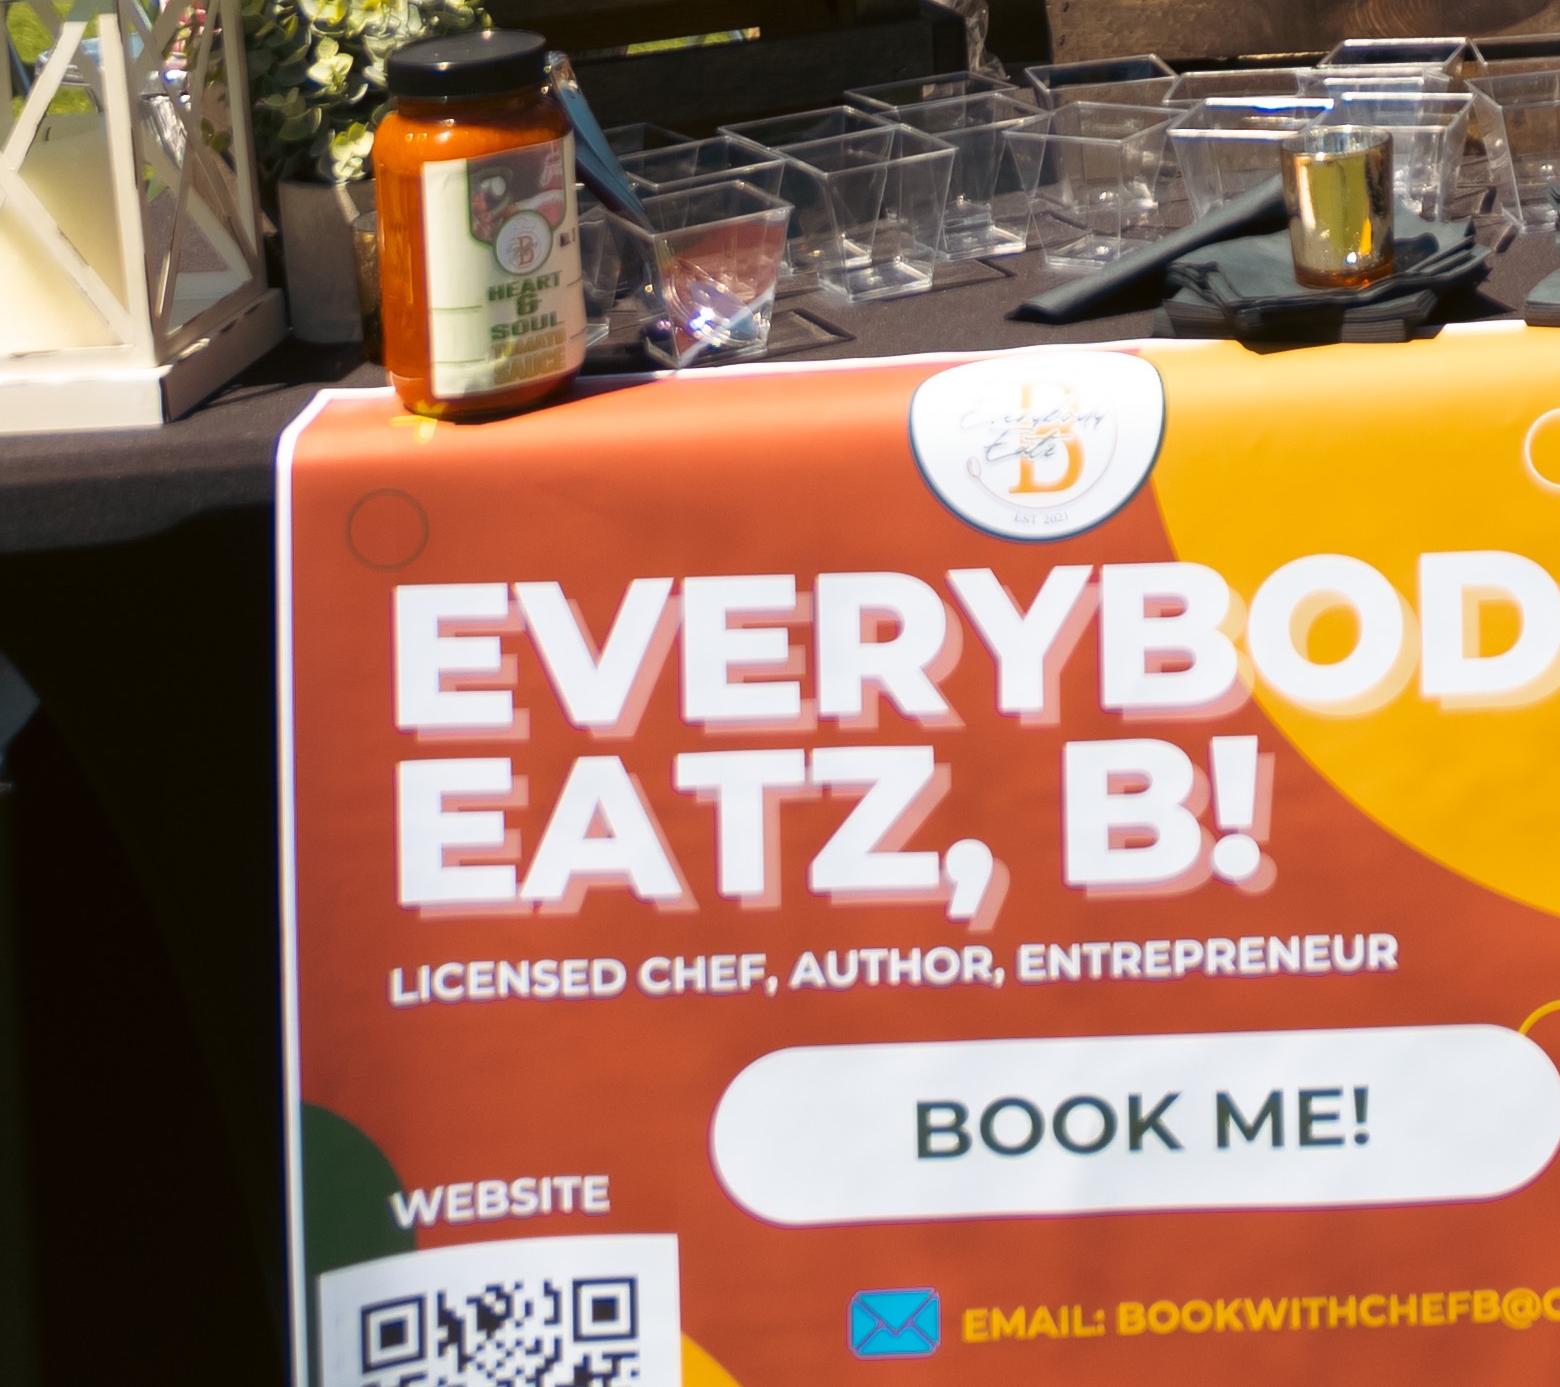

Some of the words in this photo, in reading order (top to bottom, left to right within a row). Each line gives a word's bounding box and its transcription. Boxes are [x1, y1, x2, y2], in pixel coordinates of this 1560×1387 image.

[489, 271, 562, 301] HEART
[491, 311, 565, 340] SOUL
[494, 345, 567, 385] SAUCE
[1014, 511, 1039, 525] EST
[394, 743, 998, 921] EATZ,
[1060, 735, 1268, 891] B!
[388, 959, 627, 1007] LICENSED
[638, 952, 779, 998] CHEF,
[788, 945, 1007, 991] AUTHOR,
[1016, 932, 1399, 984] ENTREPRENEUR
[913, 1091, 1182, 1162] BOOK
[1212, 1085, 1373, 1151] ME!
[390, 1172, 611, 1227] WEBSITE
[961, 1300, 1106, 1345] EMAIL:
